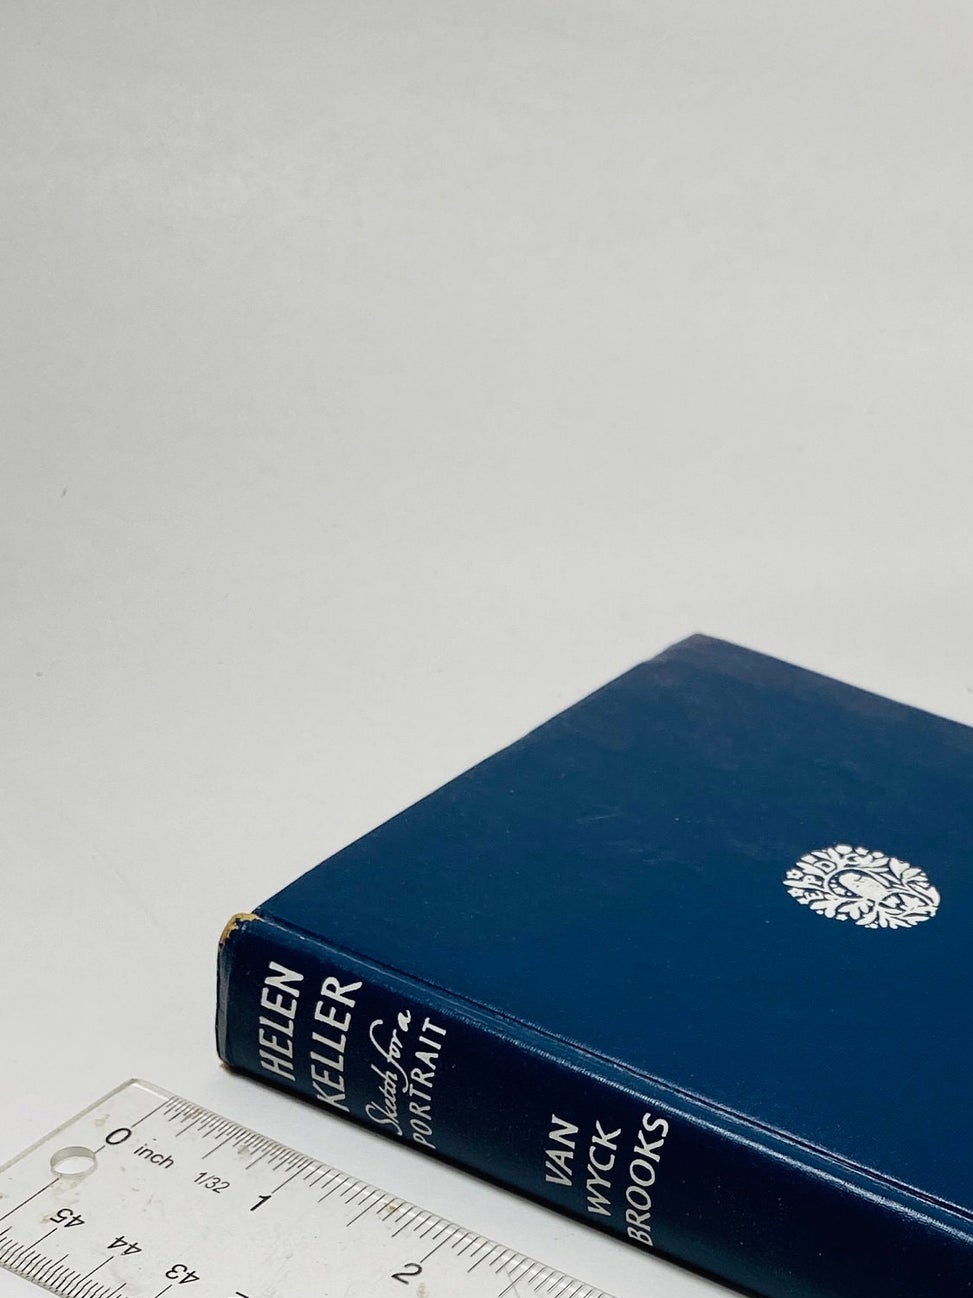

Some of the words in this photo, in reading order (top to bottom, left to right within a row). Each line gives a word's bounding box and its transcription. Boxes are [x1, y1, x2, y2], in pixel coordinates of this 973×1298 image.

[260, 962, 304, 1081] HELEN
[311, 976, 363, 1112] KELLER
[396, 1010, 411, 1031] a
[370, 1019, 408, 1093] for
[413, 1018, 447, 1149] PORTRAIT
[364, 1065, 404, 1136] Sketch
[105, 1128, 132, 1145] 0
[134, 1140, 174, 1169] inch
[545, 1115, 579, 1186] VAN
[588, 1121, 621, 1217] WYCK
[194, 1172, 230, 1193] 1/32
[250, 1195, 271, 1212] 1
[629, 1114, 668, 1247] BROOKS
[51, 1208, 85, 1229] 45
[107, 1236, 142, 1257] 44
[166, 1264, 200, 1285] 43
[392, 1263, 423, 1284] 2
